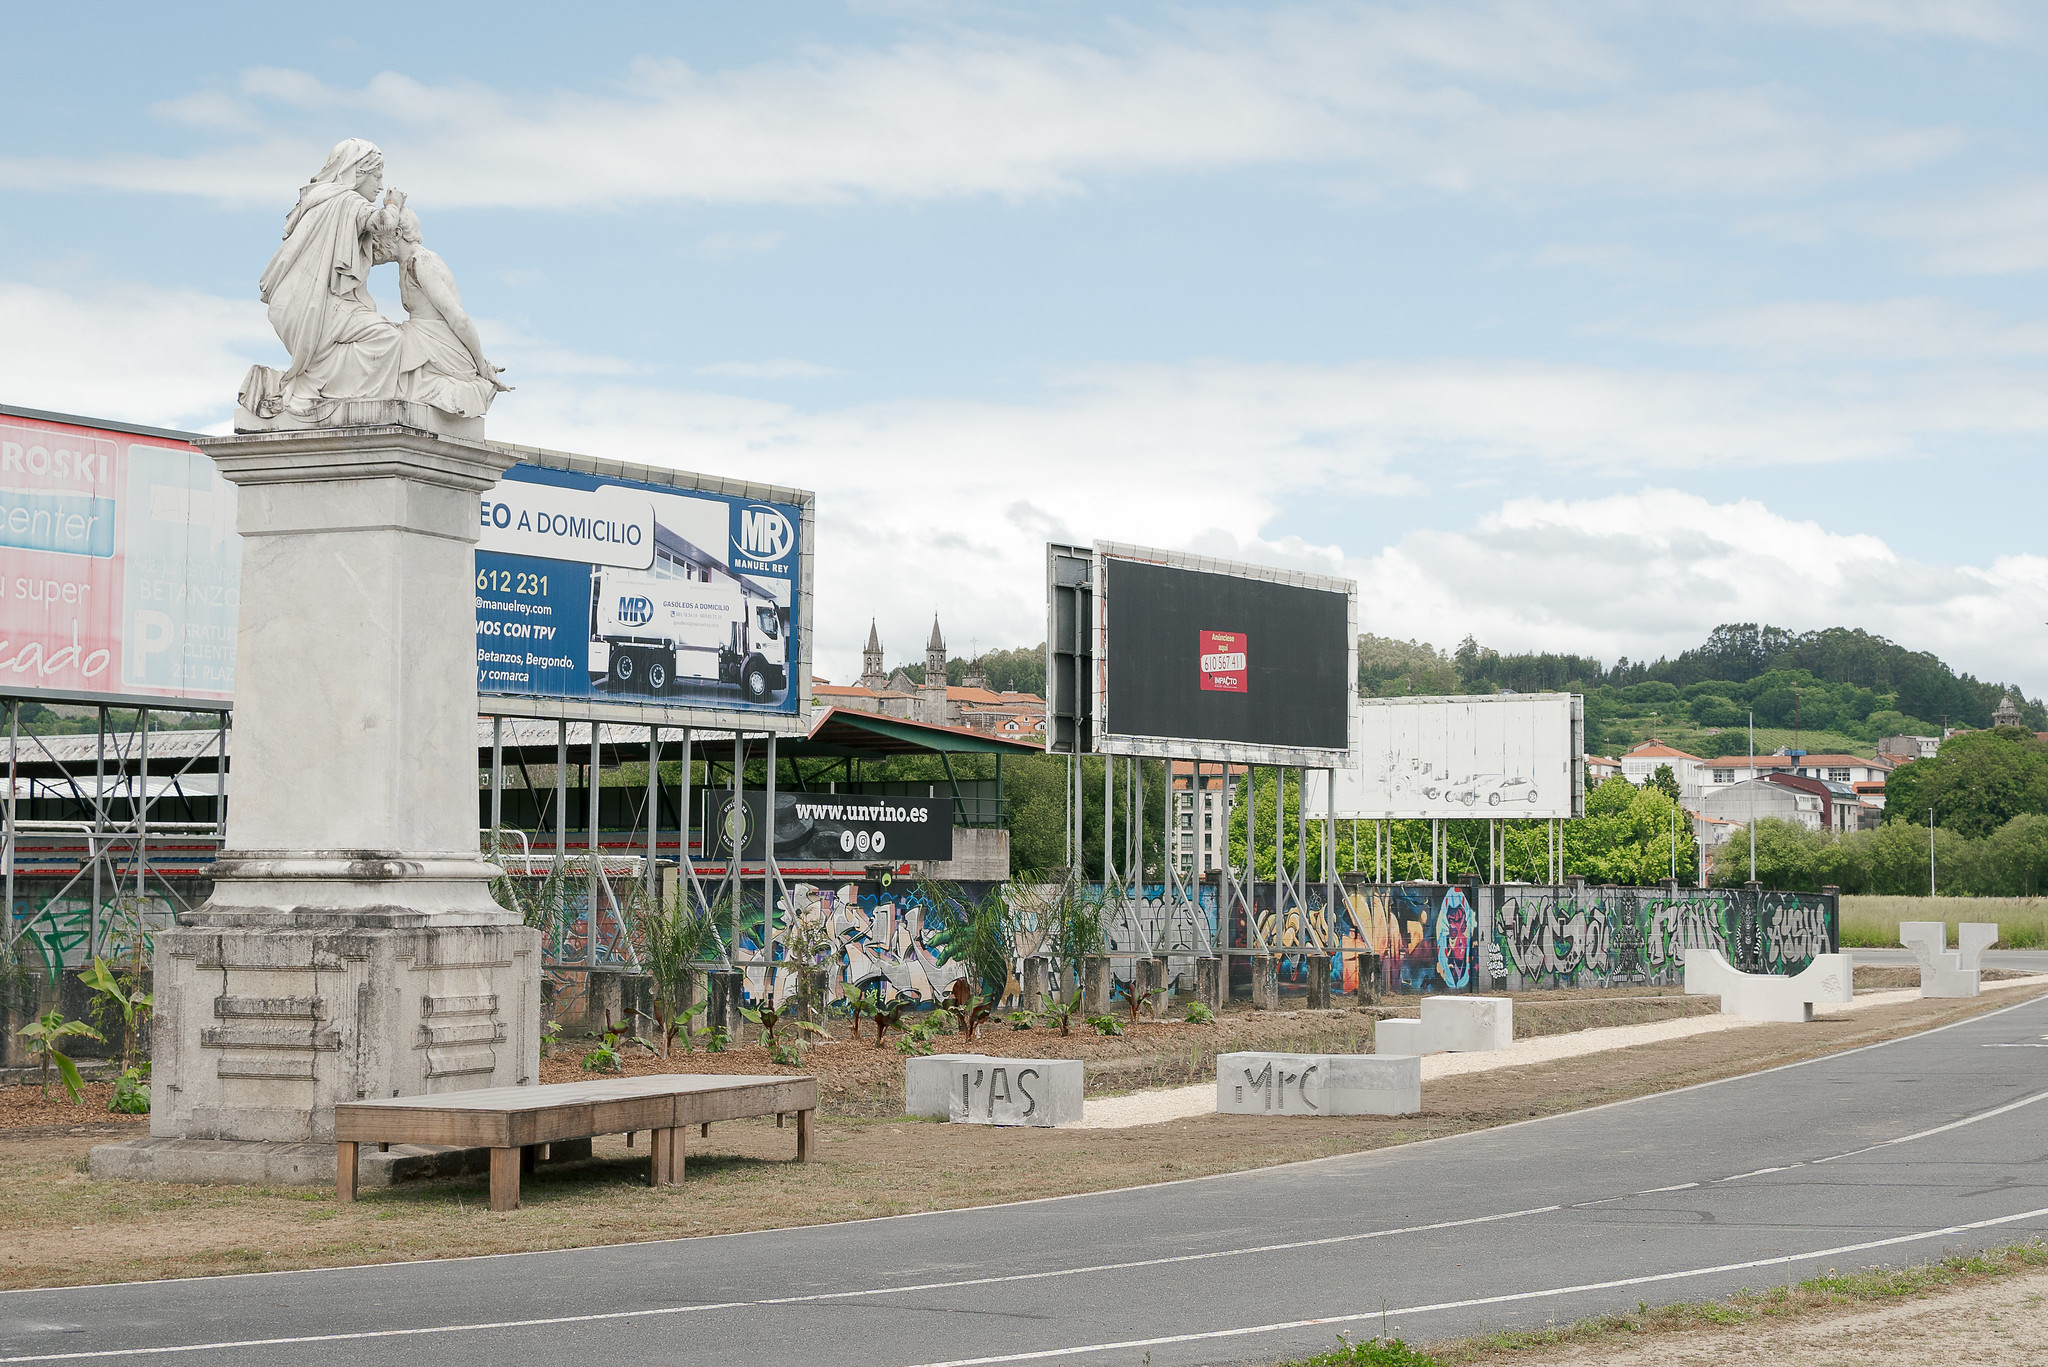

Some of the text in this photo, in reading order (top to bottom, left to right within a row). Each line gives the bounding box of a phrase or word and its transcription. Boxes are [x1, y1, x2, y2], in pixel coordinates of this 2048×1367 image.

[2, 441, 108, 484] ROSKI
[517, 510, 531, 532] A
[537, 512, 642, 545] DOMICILIO
[741, 509, 784, 554] MR
[734, 559, 789, 574] MANUEL REY
[476, 568, 548, 596] 612 231
[15, 577, 91, 611] super
[618, 596, 648, 623] MR
[700, 603, 730, 611] DOMICILIO
[503, 622, 531, 638] CON
[533, 625, 557, 641] TPV
[133, 609, 175, 678] P
[477, 648, 575, 670] Betanzos, Bergondo,
[1204, 654, 1243, 671] 610 567 411
[172, 662, 197, 679] 211
[480, 669, 529, 682] y comarca
[795, 800, 928, 822] www.unvino.es
